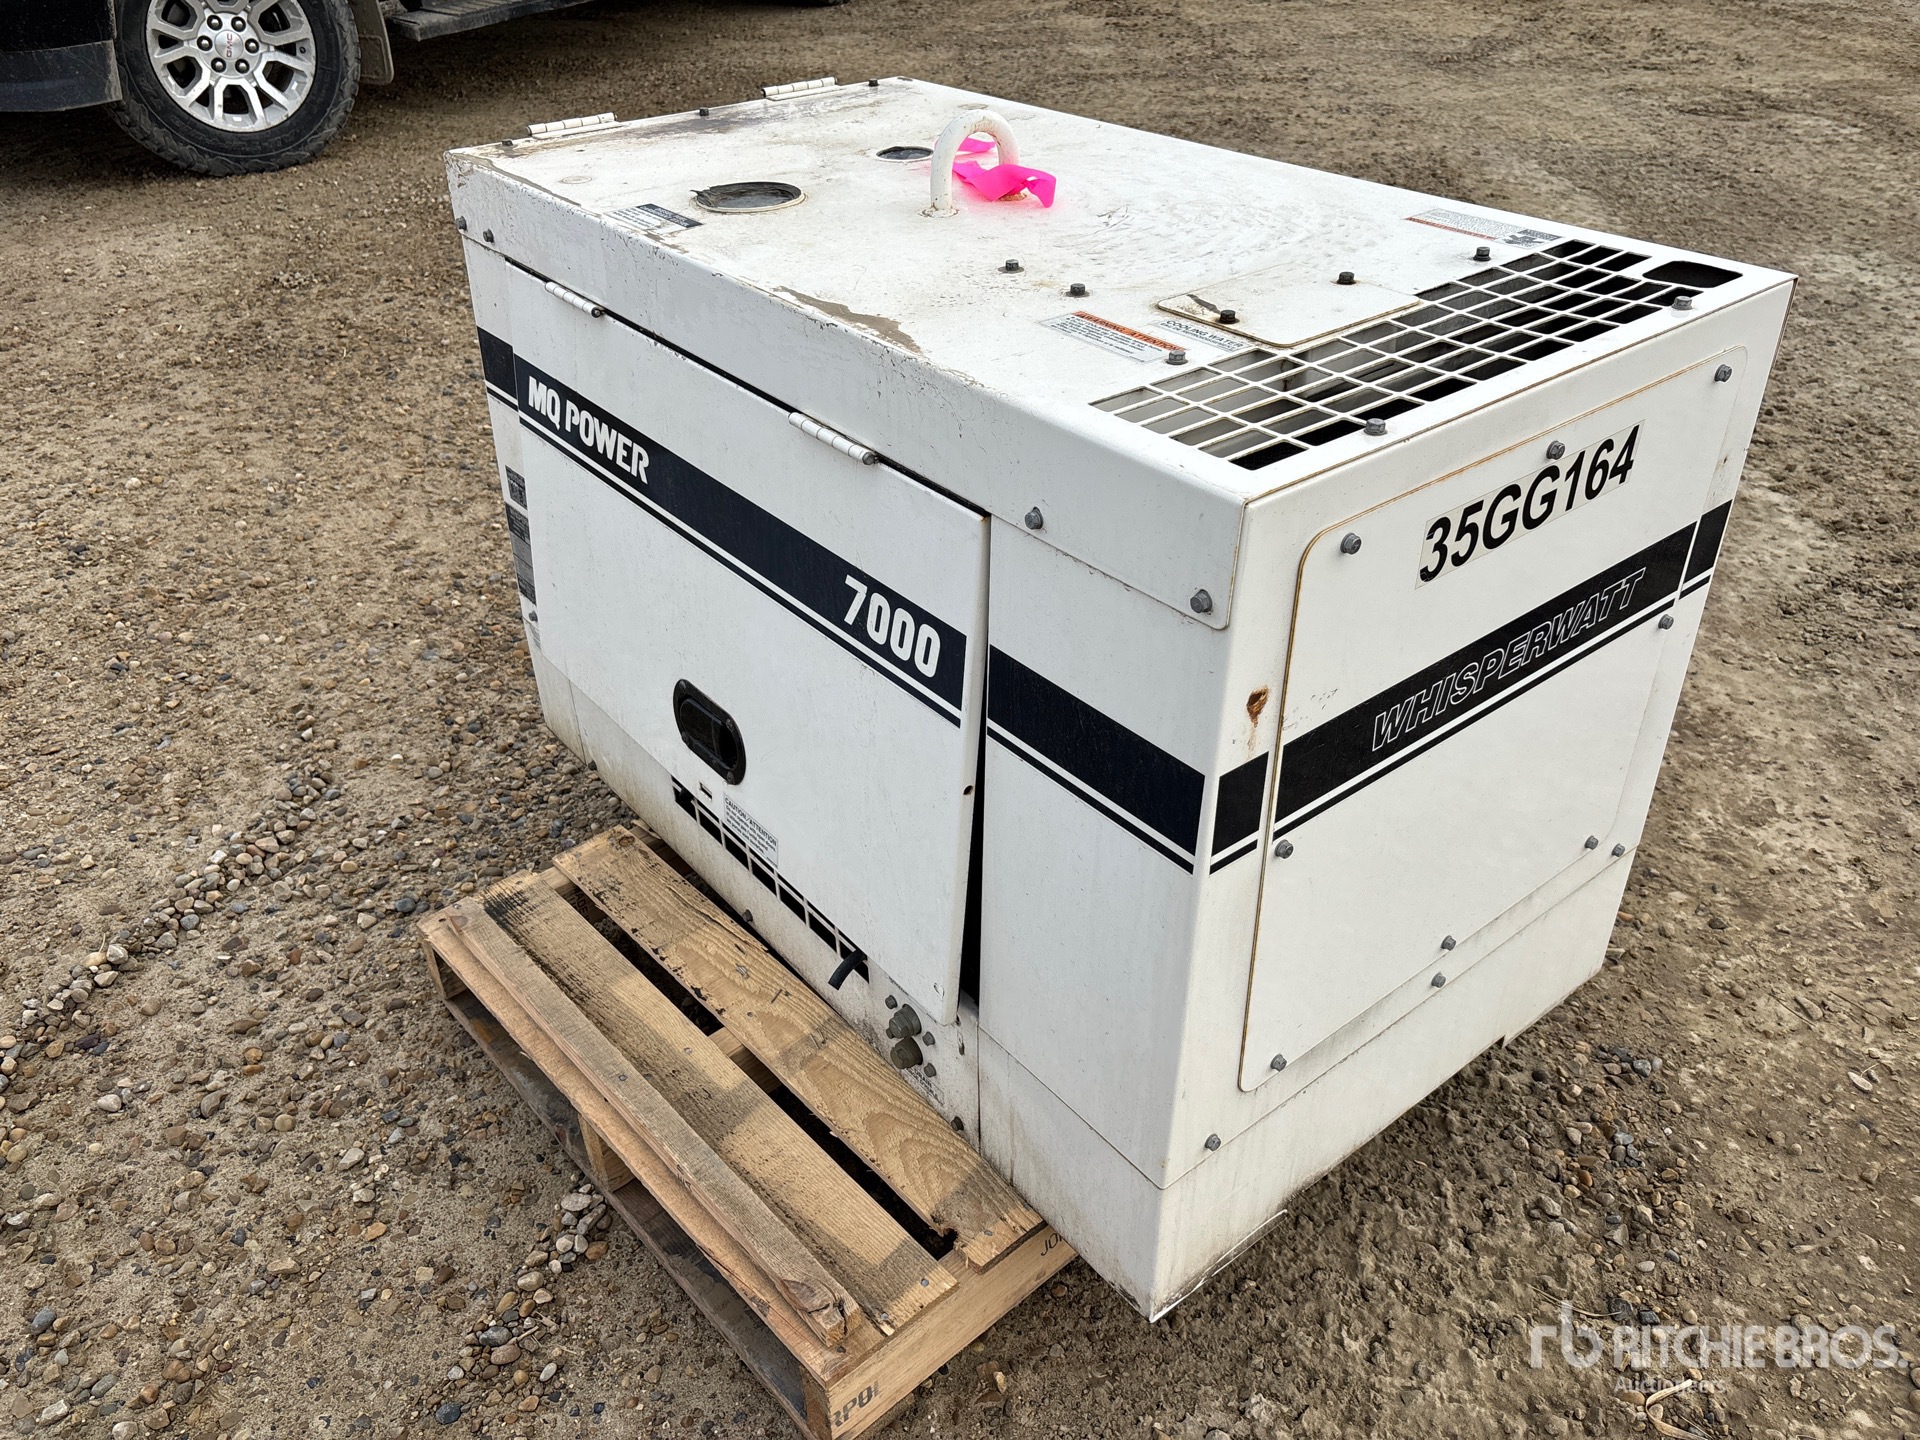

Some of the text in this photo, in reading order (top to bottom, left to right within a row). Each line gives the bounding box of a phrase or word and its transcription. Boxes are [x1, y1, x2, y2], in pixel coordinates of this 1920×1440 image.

[1209, 334, 1244, 348] WATER
[528, 375, 649, 485] MQ POWER
[1419, 424, 1640, 583] 35GG164
[844, 574, 941, 678] 7000
[1372, 567, 1647, 751] WHISPERWATT
